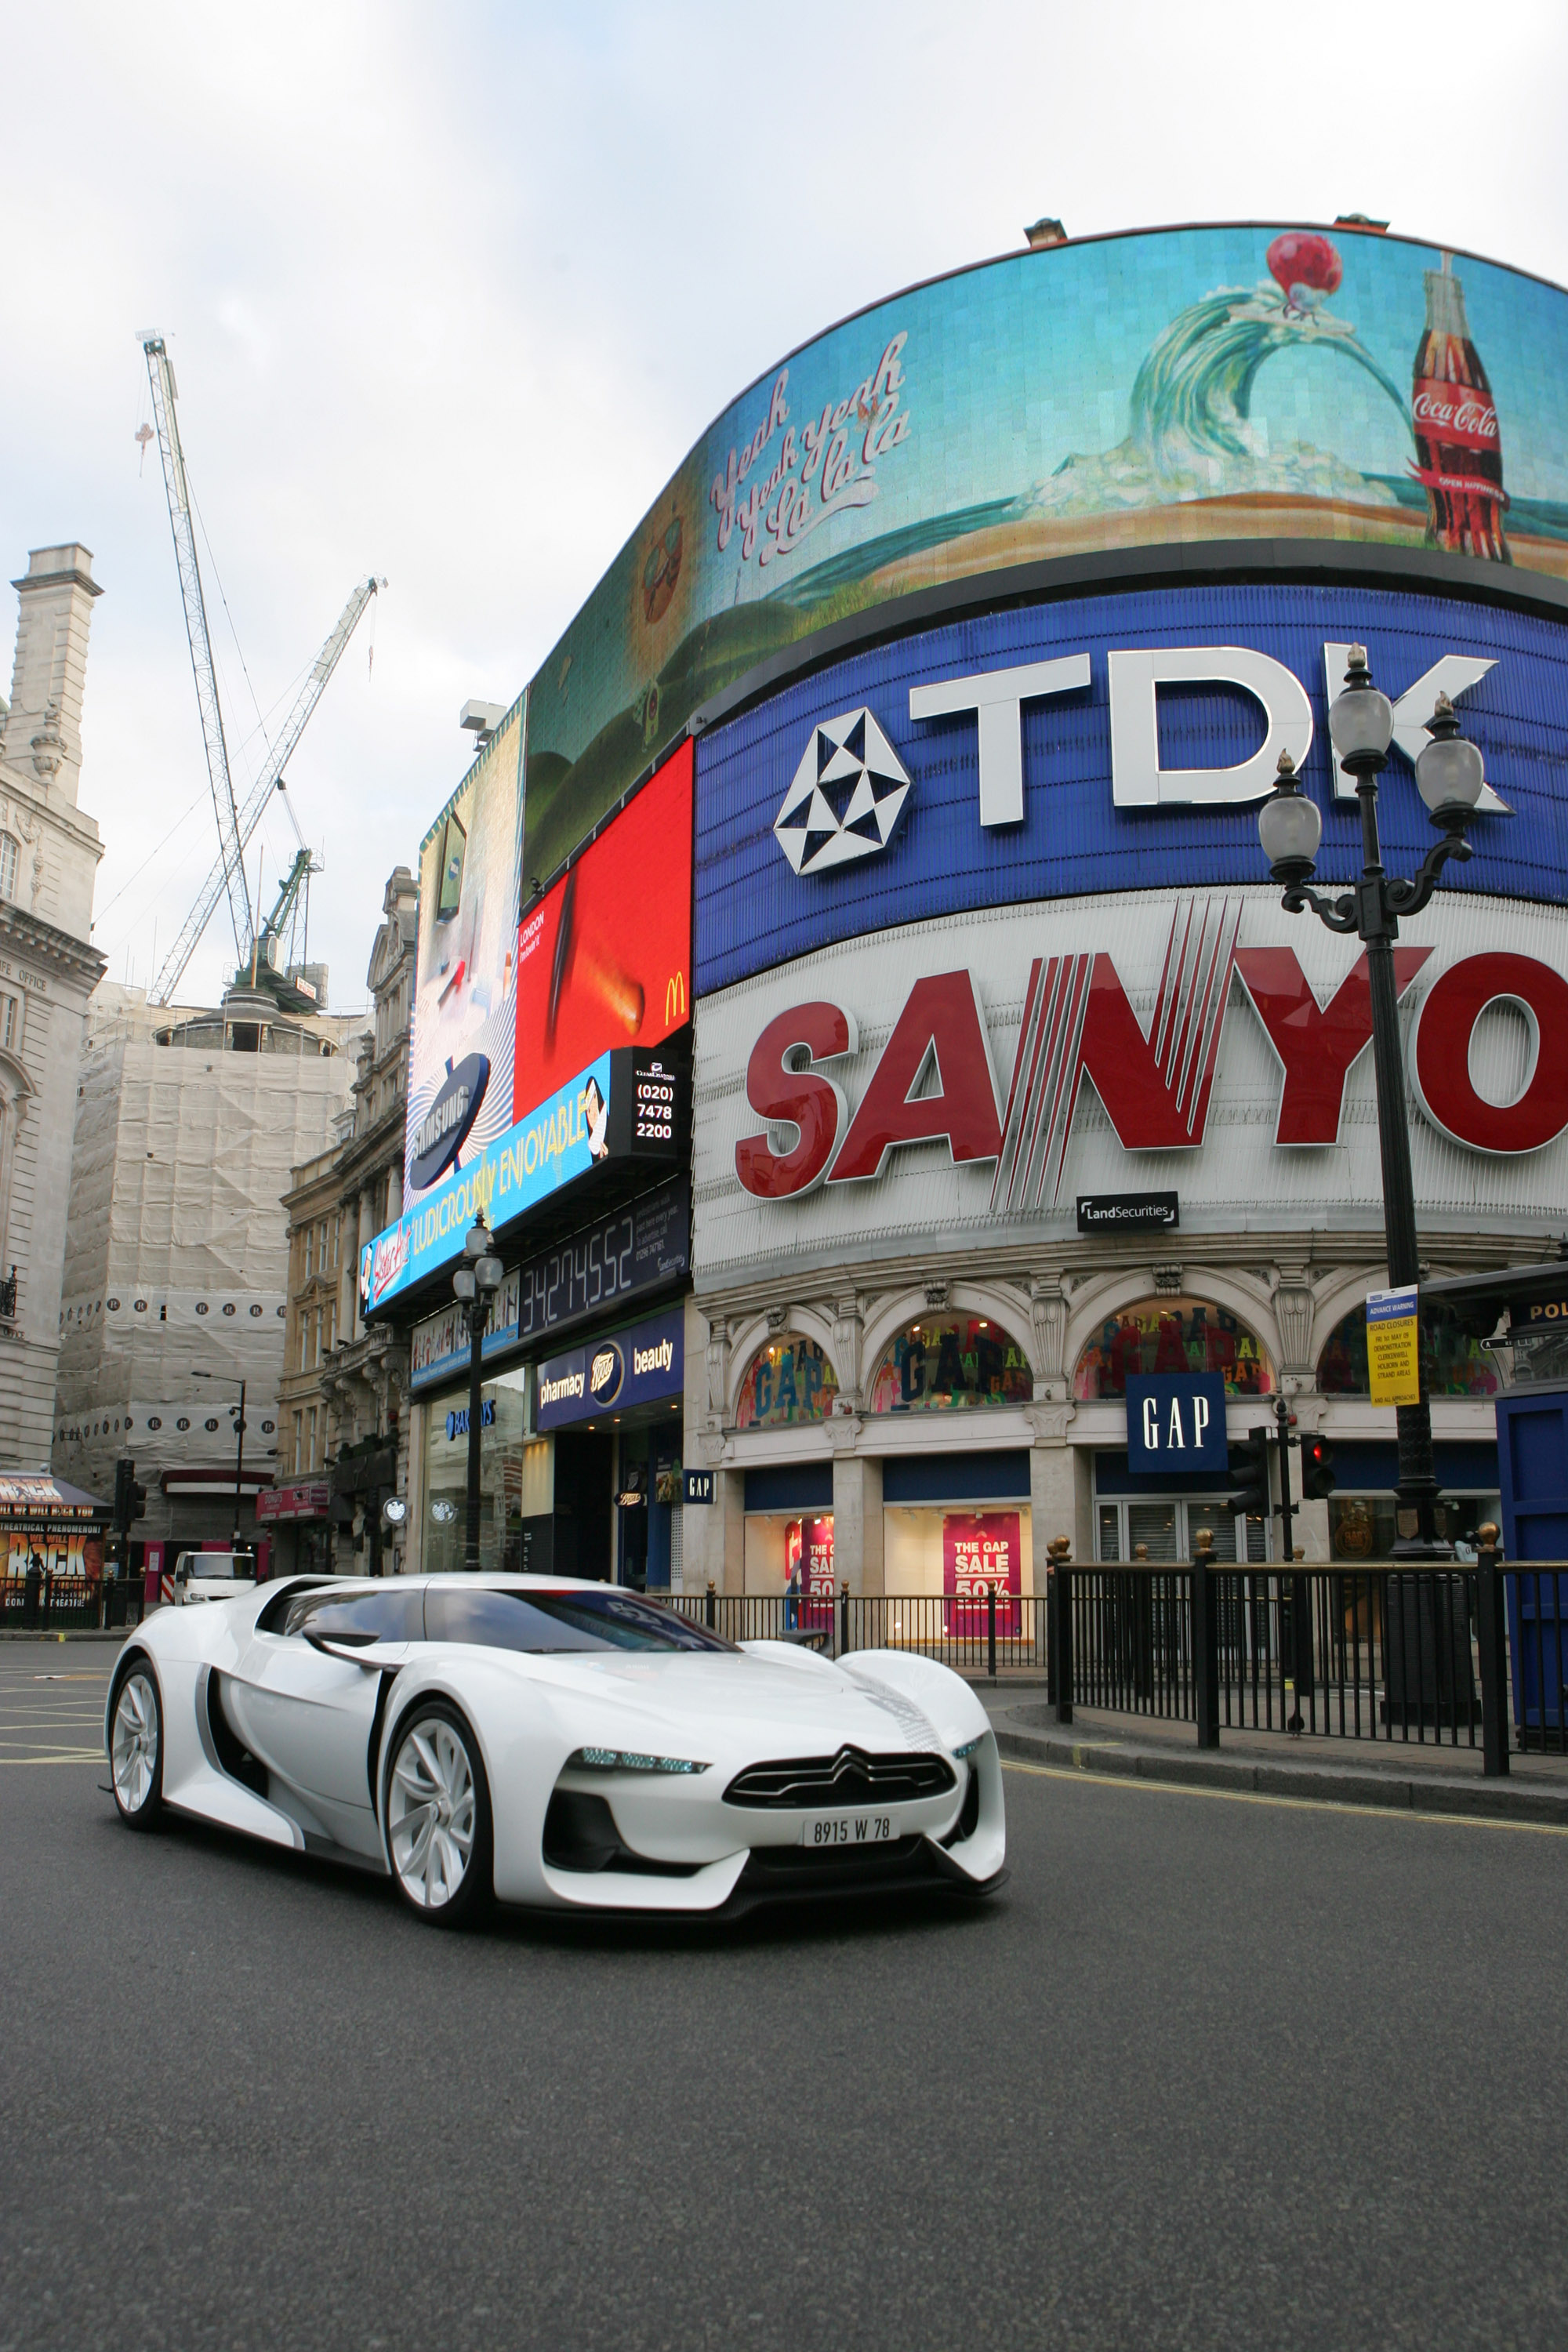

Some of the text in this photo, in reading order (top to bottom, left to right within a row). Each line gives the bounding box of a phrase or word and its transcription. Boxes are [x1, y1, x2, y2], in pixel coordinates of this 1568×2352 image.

[1413, 392, 1497, 437] Coca-Cola
[1439, 476, 1462, 488] OPEN
[909, 642, 1517, 827] TDK
[520, 910, 544, 948] LONDON
[735, 894, 1568, 1211] SANYO
[637, 1083, 673, 1102] (020)
[637, 1103, 672, 1120] 7478
[413, 1085, 469, 1160] SAMSUNG
[636, 1122, 672, 1139] 2200
[1087, 1205, 1168, 1220] LandSecurities
[1370, 1301, 1414, 1315] ADVANCE WARNING
[1530, 1301, 1568, 1320] POL
[1370, 1319, 1414, 1331] ROAD CLOSURES
[1374, 1341, 1411, 1352] DEMONSTRATION
[1377, 1351, 1407, 1361] CLERKENWELL
[540, 1338, 673, 1410] pharmacy Boots beauty
[1377, 1371, 1395, 1380] STRAND
[756, 1353, 822, 1418] GAP
[455, 1399, 495, 1435] BARYS
[1142, 1396, 1210, 1450] GAP
[689, 1477, 710, 1497] GAP
[618, 1492, 641, 1505] Boots
[13, 1504, 27, 1515] WE
[29, 1504, 49, 1516] WILL
[51, 1504, 74, 1517] ROCK
[77, 1505, 94, 1518] YOU
[0, 1523, 101, 1534] THEATRICAL PHENOMENON!
[30, 1534, 68, 1544] WE WILL
[954, 1541, 1009, 1554] THE GAP
[810, 1544, 828, 1555] THE
[7, 1533, 88, 1589] ROCK
[954, 1554, 1010, 1573] SALE
[814, 1817, 891, 1844] 8915 W 78
